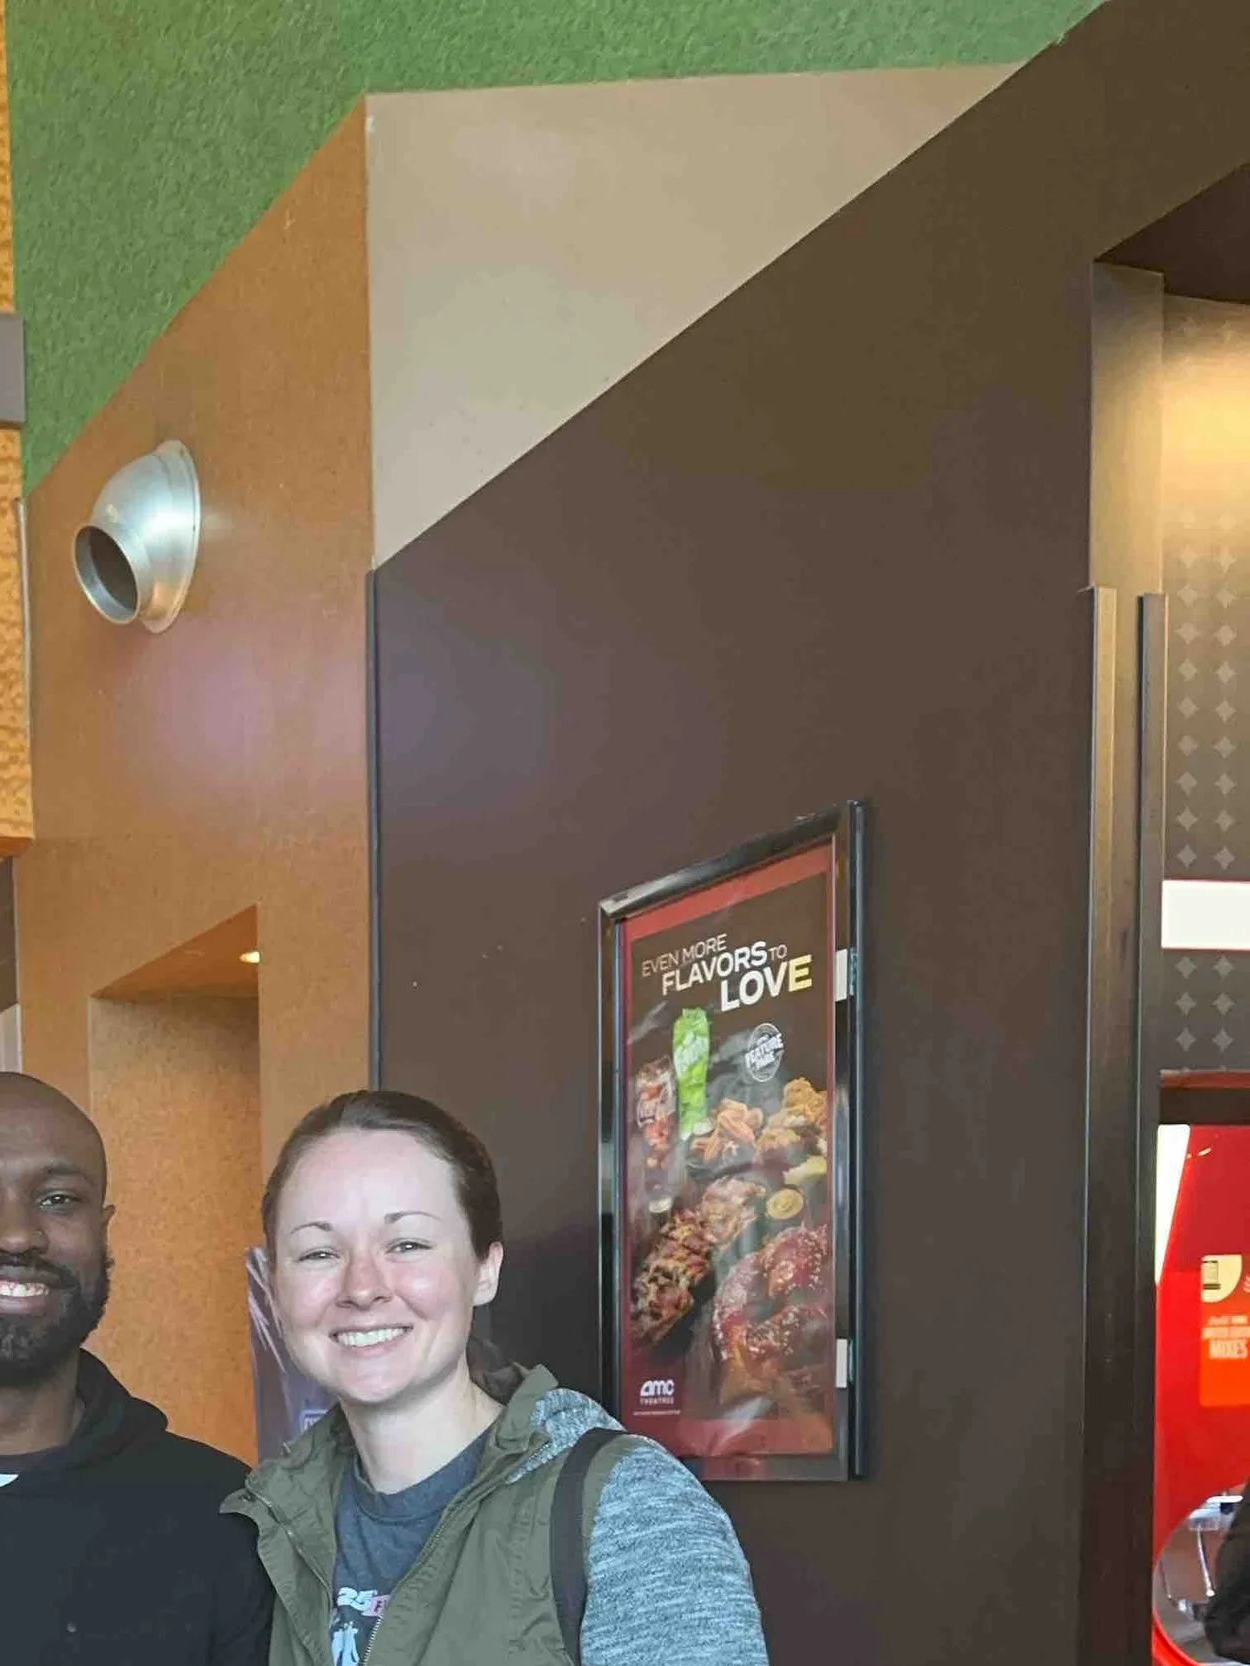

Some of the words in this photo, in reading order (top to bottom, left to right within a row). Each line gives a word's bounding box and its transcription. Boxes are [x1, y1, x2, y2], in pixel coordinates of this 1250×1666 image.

[642, 950, 679, 977] EVEN
[682, 933, 728, 965] MORE
[662, 941, 768, 996] FLAVORS
[768, 944, 788, 961] TO
[720, 954, 813, 1012] LOVE
[336, 1587, 378, 1612] 25
